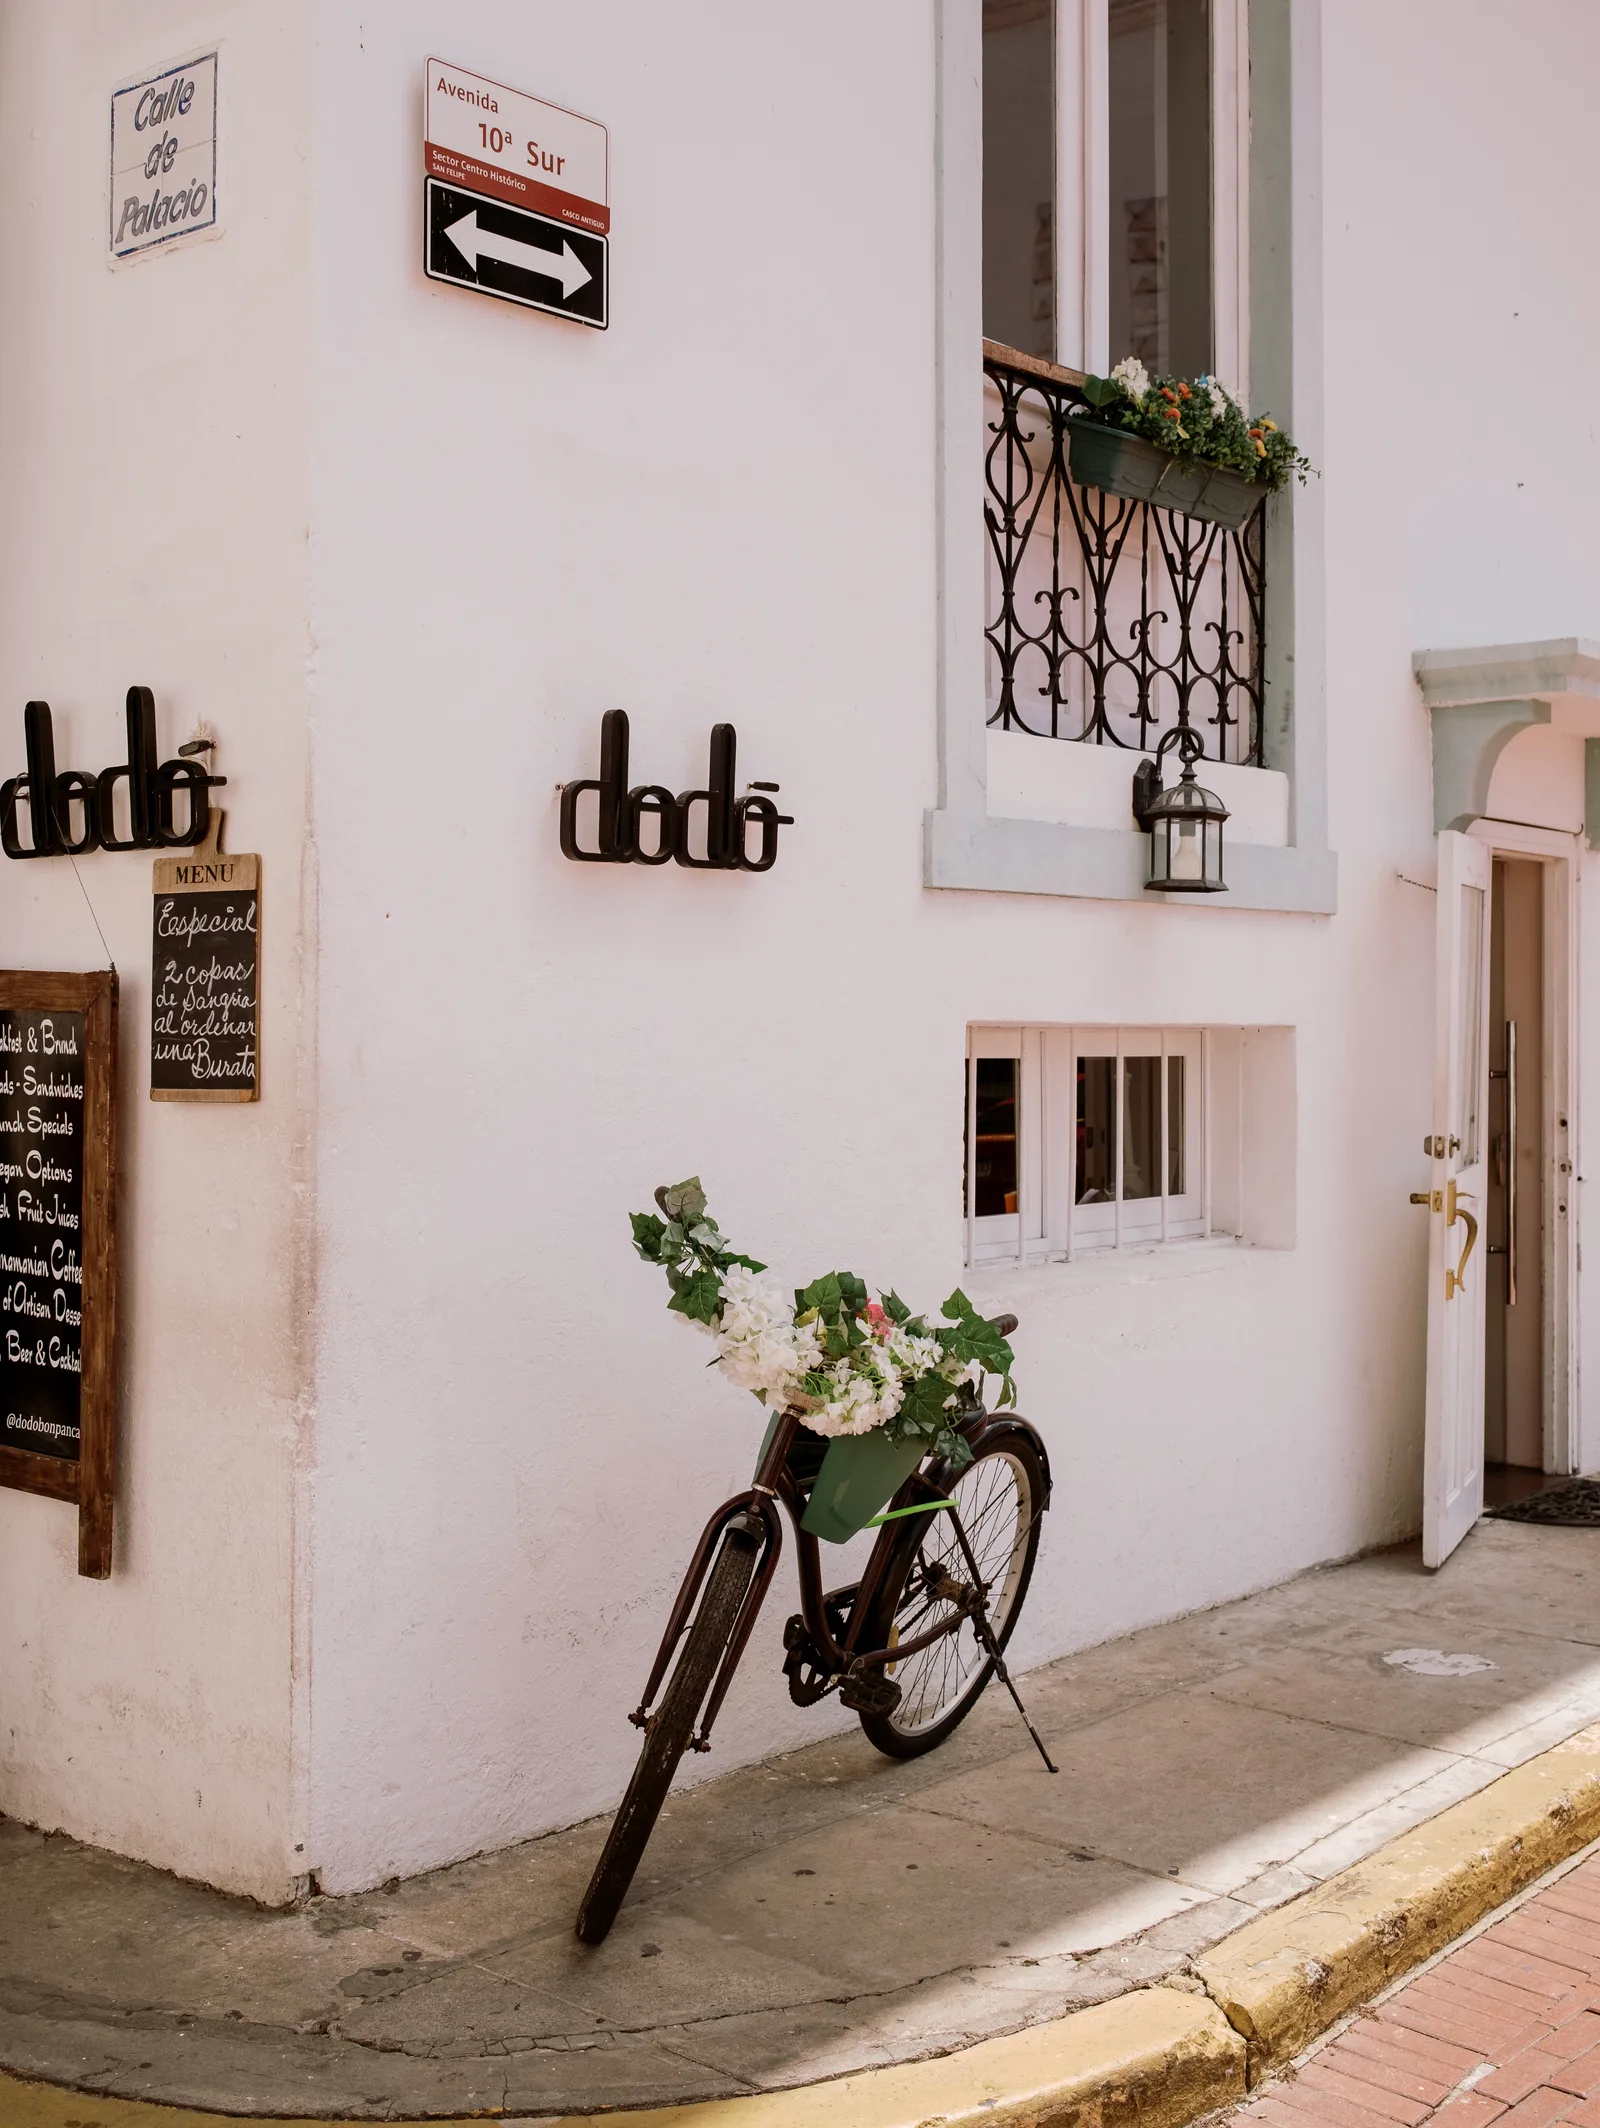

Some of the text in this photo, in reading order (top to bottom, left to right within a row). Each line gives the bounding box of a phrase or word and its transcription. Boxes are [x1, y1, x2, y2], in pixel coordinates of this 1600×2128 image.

[134, 77, 195, 131] Calle
[437, 77, 499, 114] Avenida
[144, 130, 178, 180] de
[432, 150, 527, 191] Sector Centro Histórico
[432, 163, 466, 181] SAN FELIPE
[527, 141, 566, 176] Sur
[115, 178, 208, 243] Palacio
[562, 209, 605, 230] CASCO ANTIGUO
[175, 863, 234, 885] MENU
[165, 955, 255, 997] 2 copas
[156, 984, 178, 1007] de
[27, 1027, 38, 1053] &
[40, 1018, 78, 1056] Brunch
[154, 1010, 256, 1037] al ordenar
[155, 1038, 256, 1079] una Burata
[23, 1065, 83, 1100] Sandwiches
[27, 1106, 73, 1140] Specials
[26, 1150, 73, 1187] Options
[17, 1189, 44, 1223] Fruit
[45, 1193, 79, 1230] Juices
[3, 1281, 82, 1327] of Artisan Desse
[6, 1329, 82, 1373] Beer & Cocktai
